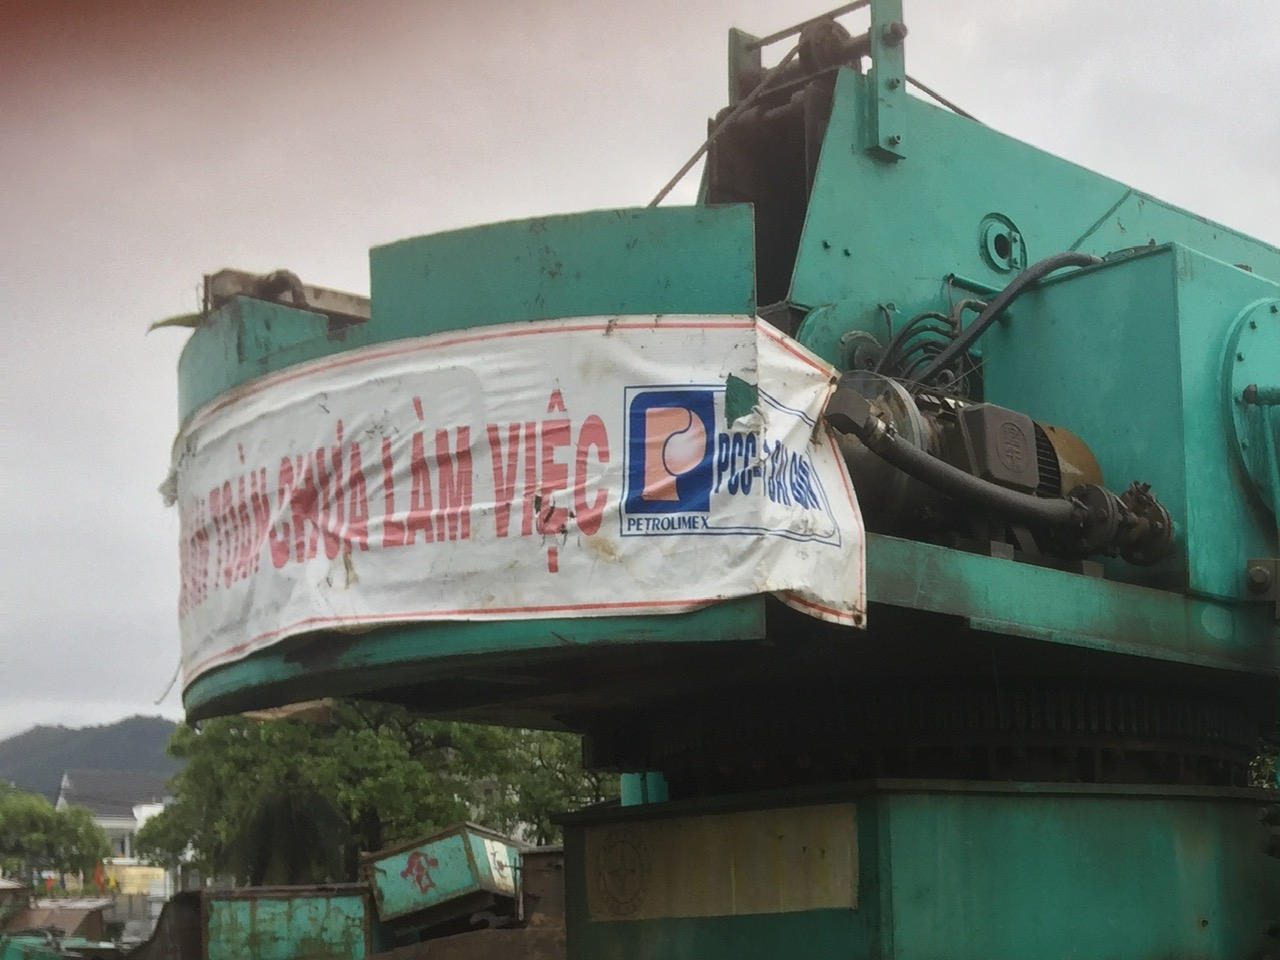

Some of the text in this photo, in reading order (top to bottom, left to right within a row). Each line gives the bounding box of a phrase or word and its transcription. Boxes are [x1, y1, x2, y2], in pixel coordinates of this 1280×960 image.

[382, 396, 473, 549] LÀM
[487, 388, 611, 573] VIỆC
[627, 514, 711, 532] PETROLIMEX
